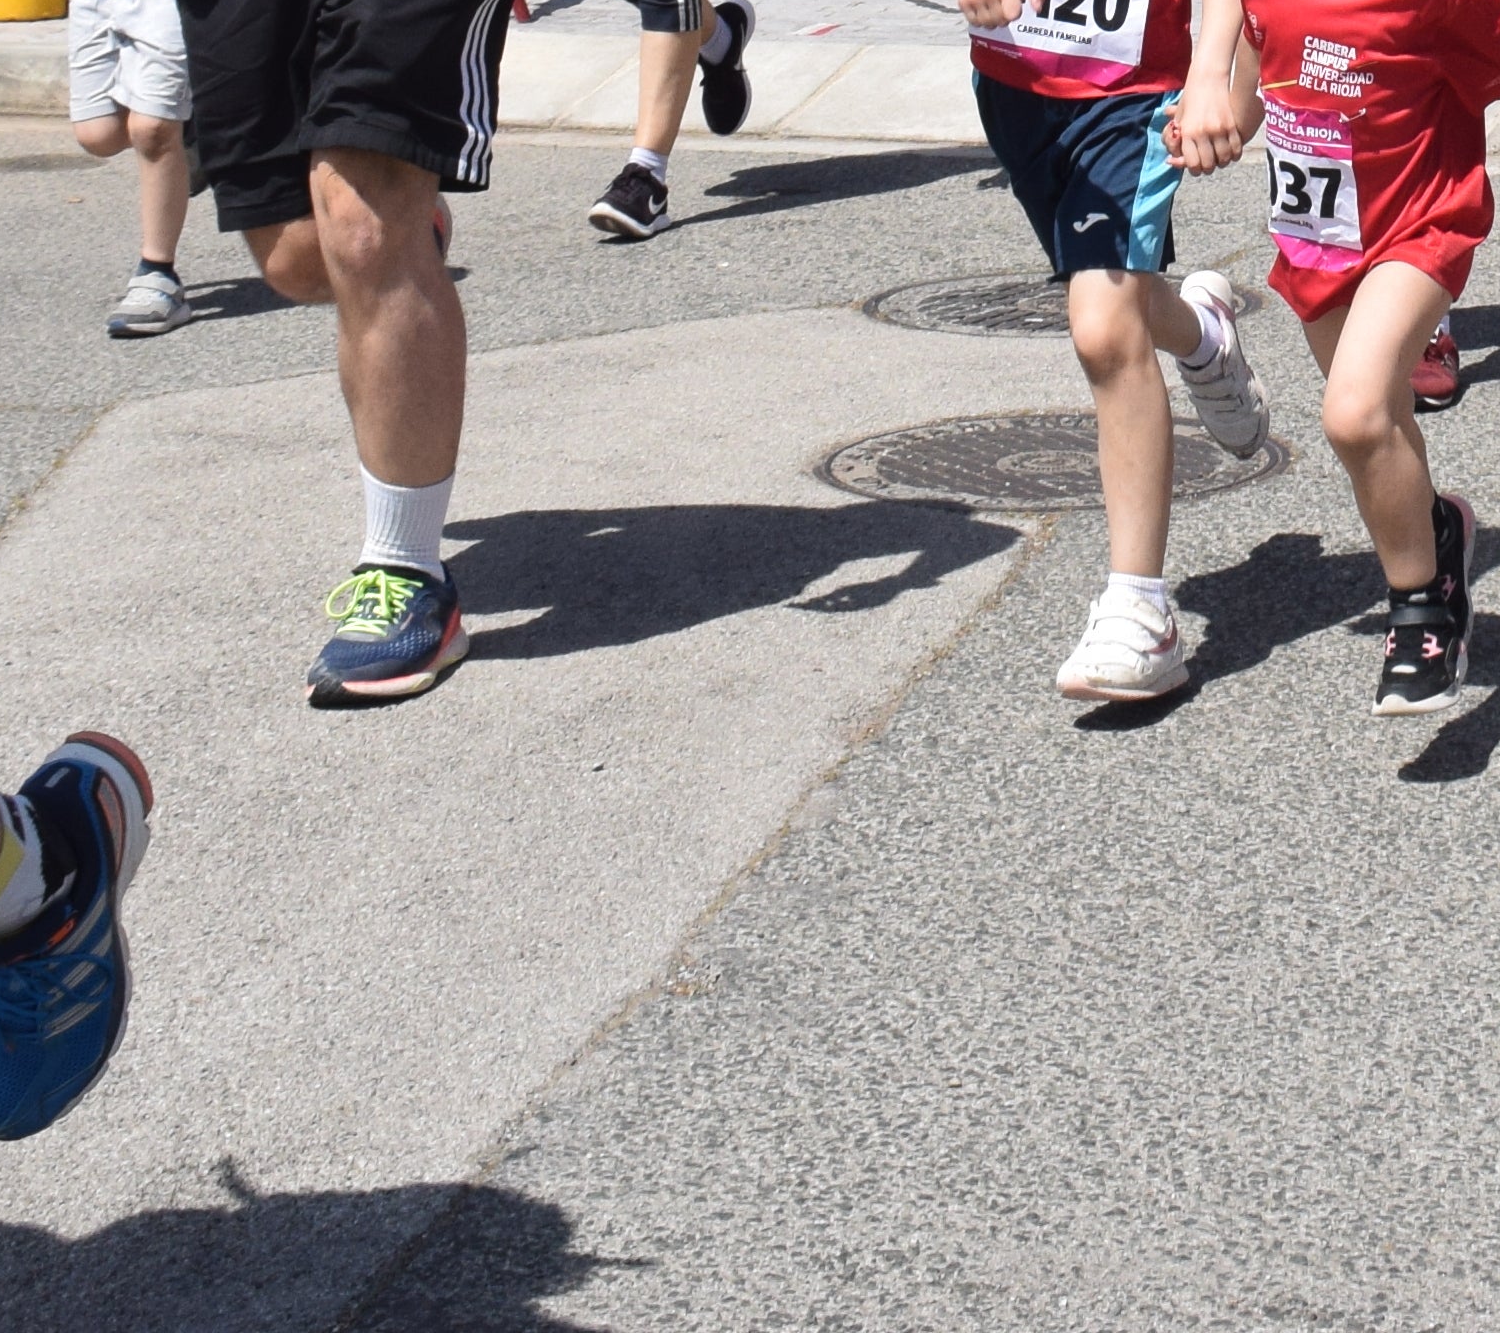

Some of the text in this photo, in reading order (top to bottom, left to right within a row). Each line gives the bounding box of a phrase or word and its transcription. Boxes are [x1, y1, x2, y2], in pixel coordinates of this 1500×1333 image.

[1017, 24, 1093, 45] CARRERA FAMILIAR
[1304, 35, 1356, 60] CARRERA
[1303, 48, 1350, 72] CAMPUS
[1301, 61, 1374, 85] UNIVERSIDAD
[1298, 75, 1362, 98] DE LA RIOJA
[1289, 124, 1305, 137] LA
[1306, 126, 1342, 142] RIOJA
[1292, 143, 1313, 154] 2022
